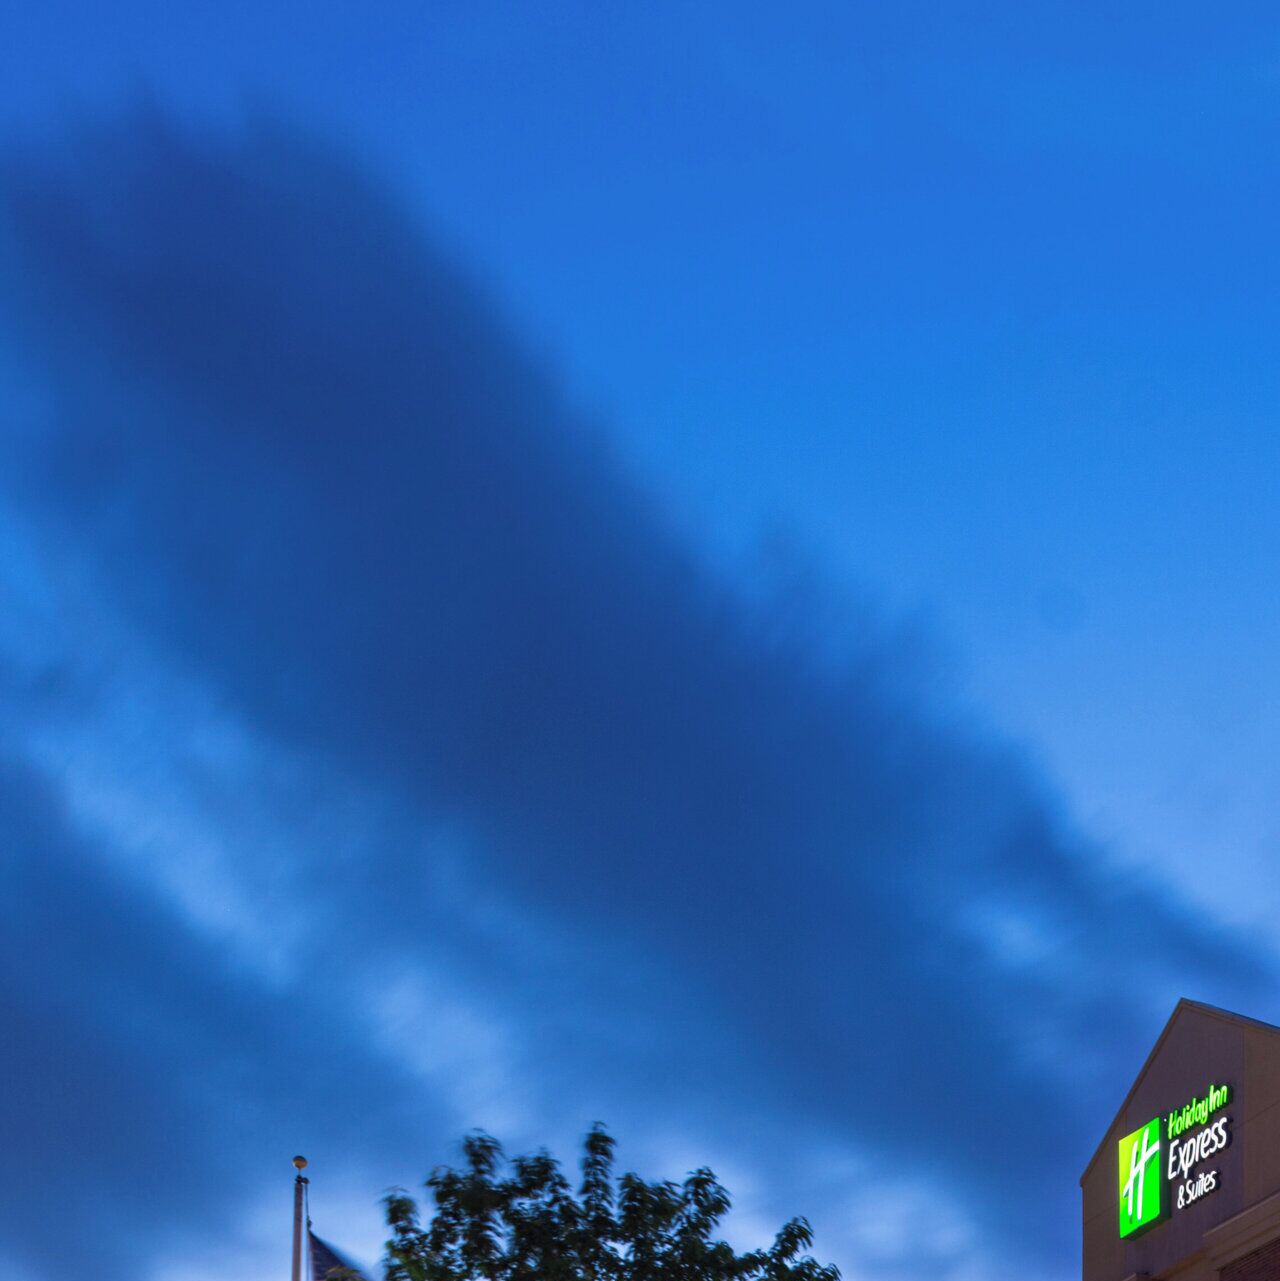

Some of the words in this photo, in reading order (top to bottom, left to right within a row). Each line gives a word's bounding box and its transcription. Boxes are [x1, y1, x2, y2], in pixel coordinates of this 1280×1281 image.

[1168, 1097, 1209, 1140] Holiday
[1209, 1084, 1228, 1113] Inn
[1167, 1117, 1228, 1180] Express
[1177, 1185, 1185, 1210] &
[1186, 1170, 1217, 1205] Suites
